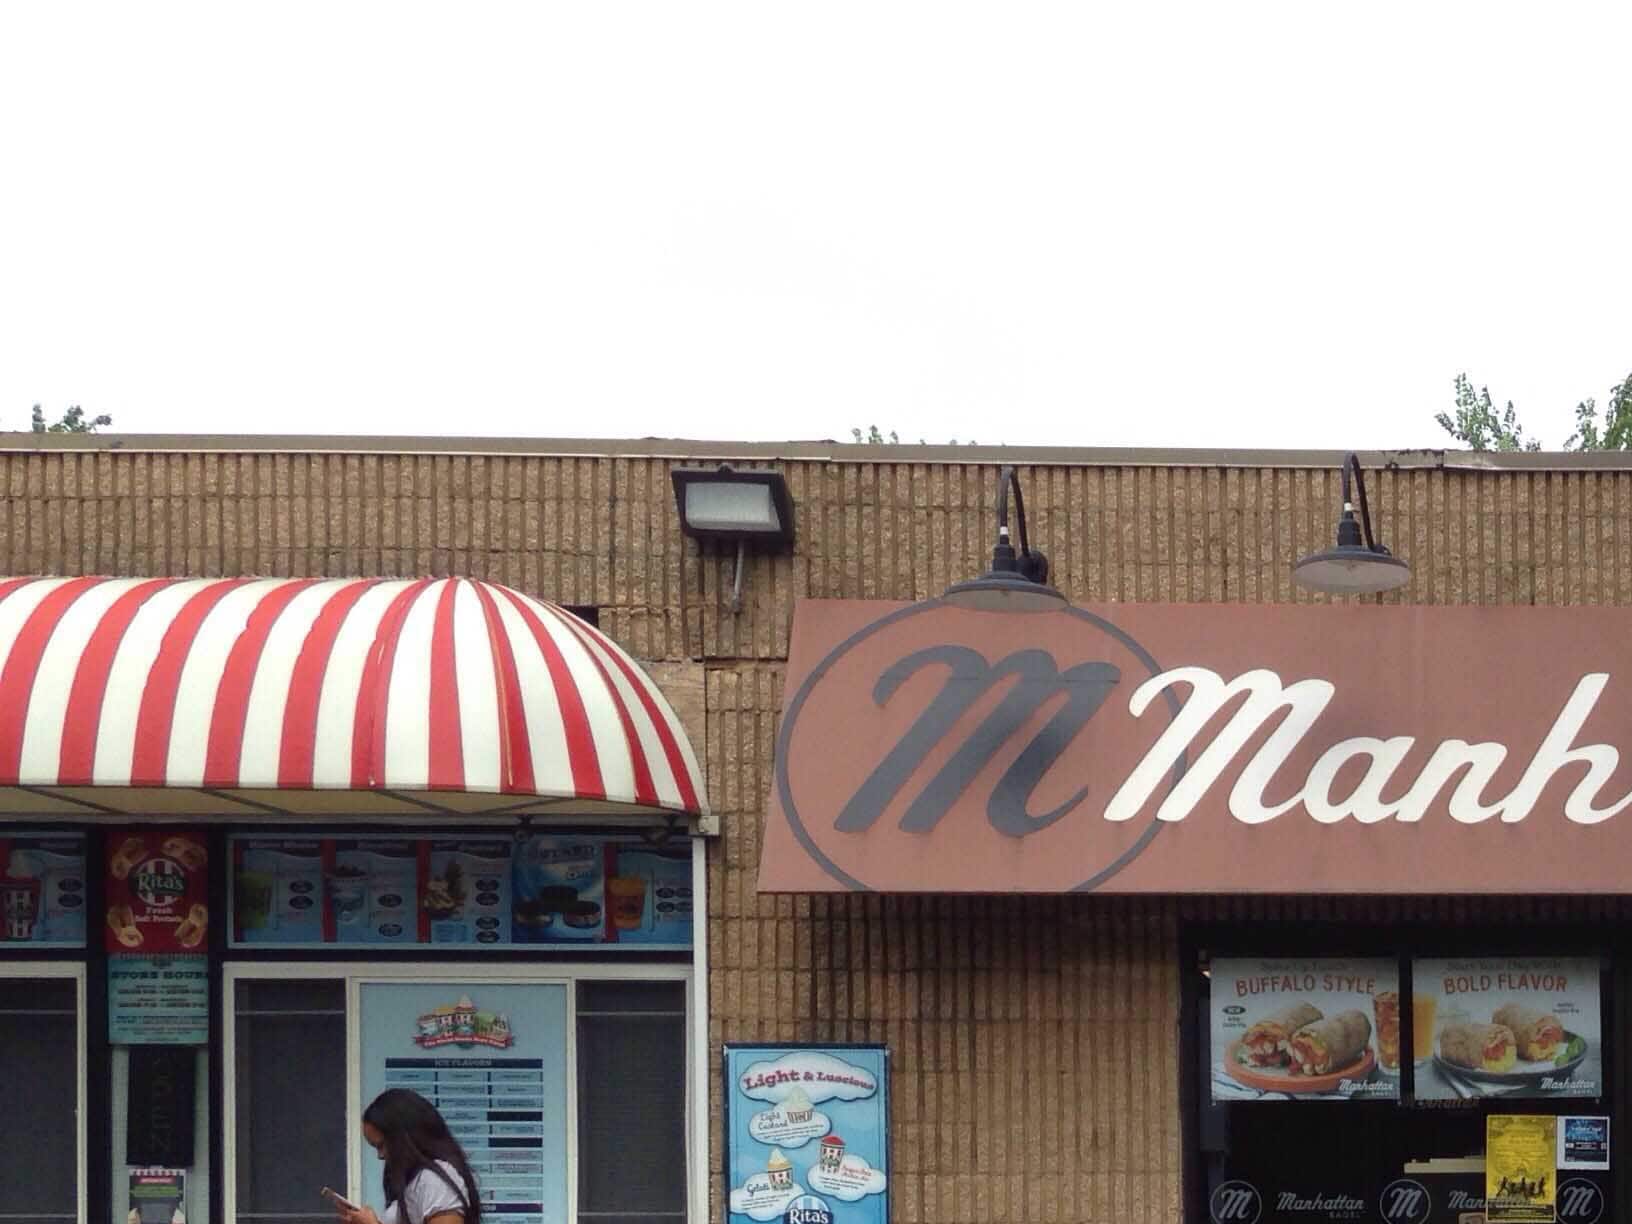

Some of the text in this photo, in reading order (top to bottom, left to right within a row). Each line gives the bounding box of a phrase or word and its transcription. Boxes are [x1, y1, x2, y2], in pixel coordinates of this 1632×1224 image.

[1234, 973, 1376, 998] BUFFALO STYLE
[1443, 973, 1568, 996] BOLD FLAVOR
[743, 1069, 875, 1091] Light & Luscious
[1338, 1078, 1394, 1092] Manhattan
[1540, 1076, 1596, 1089] Manhattan
[1274, 1191, 1366, 1211] Manhattan
